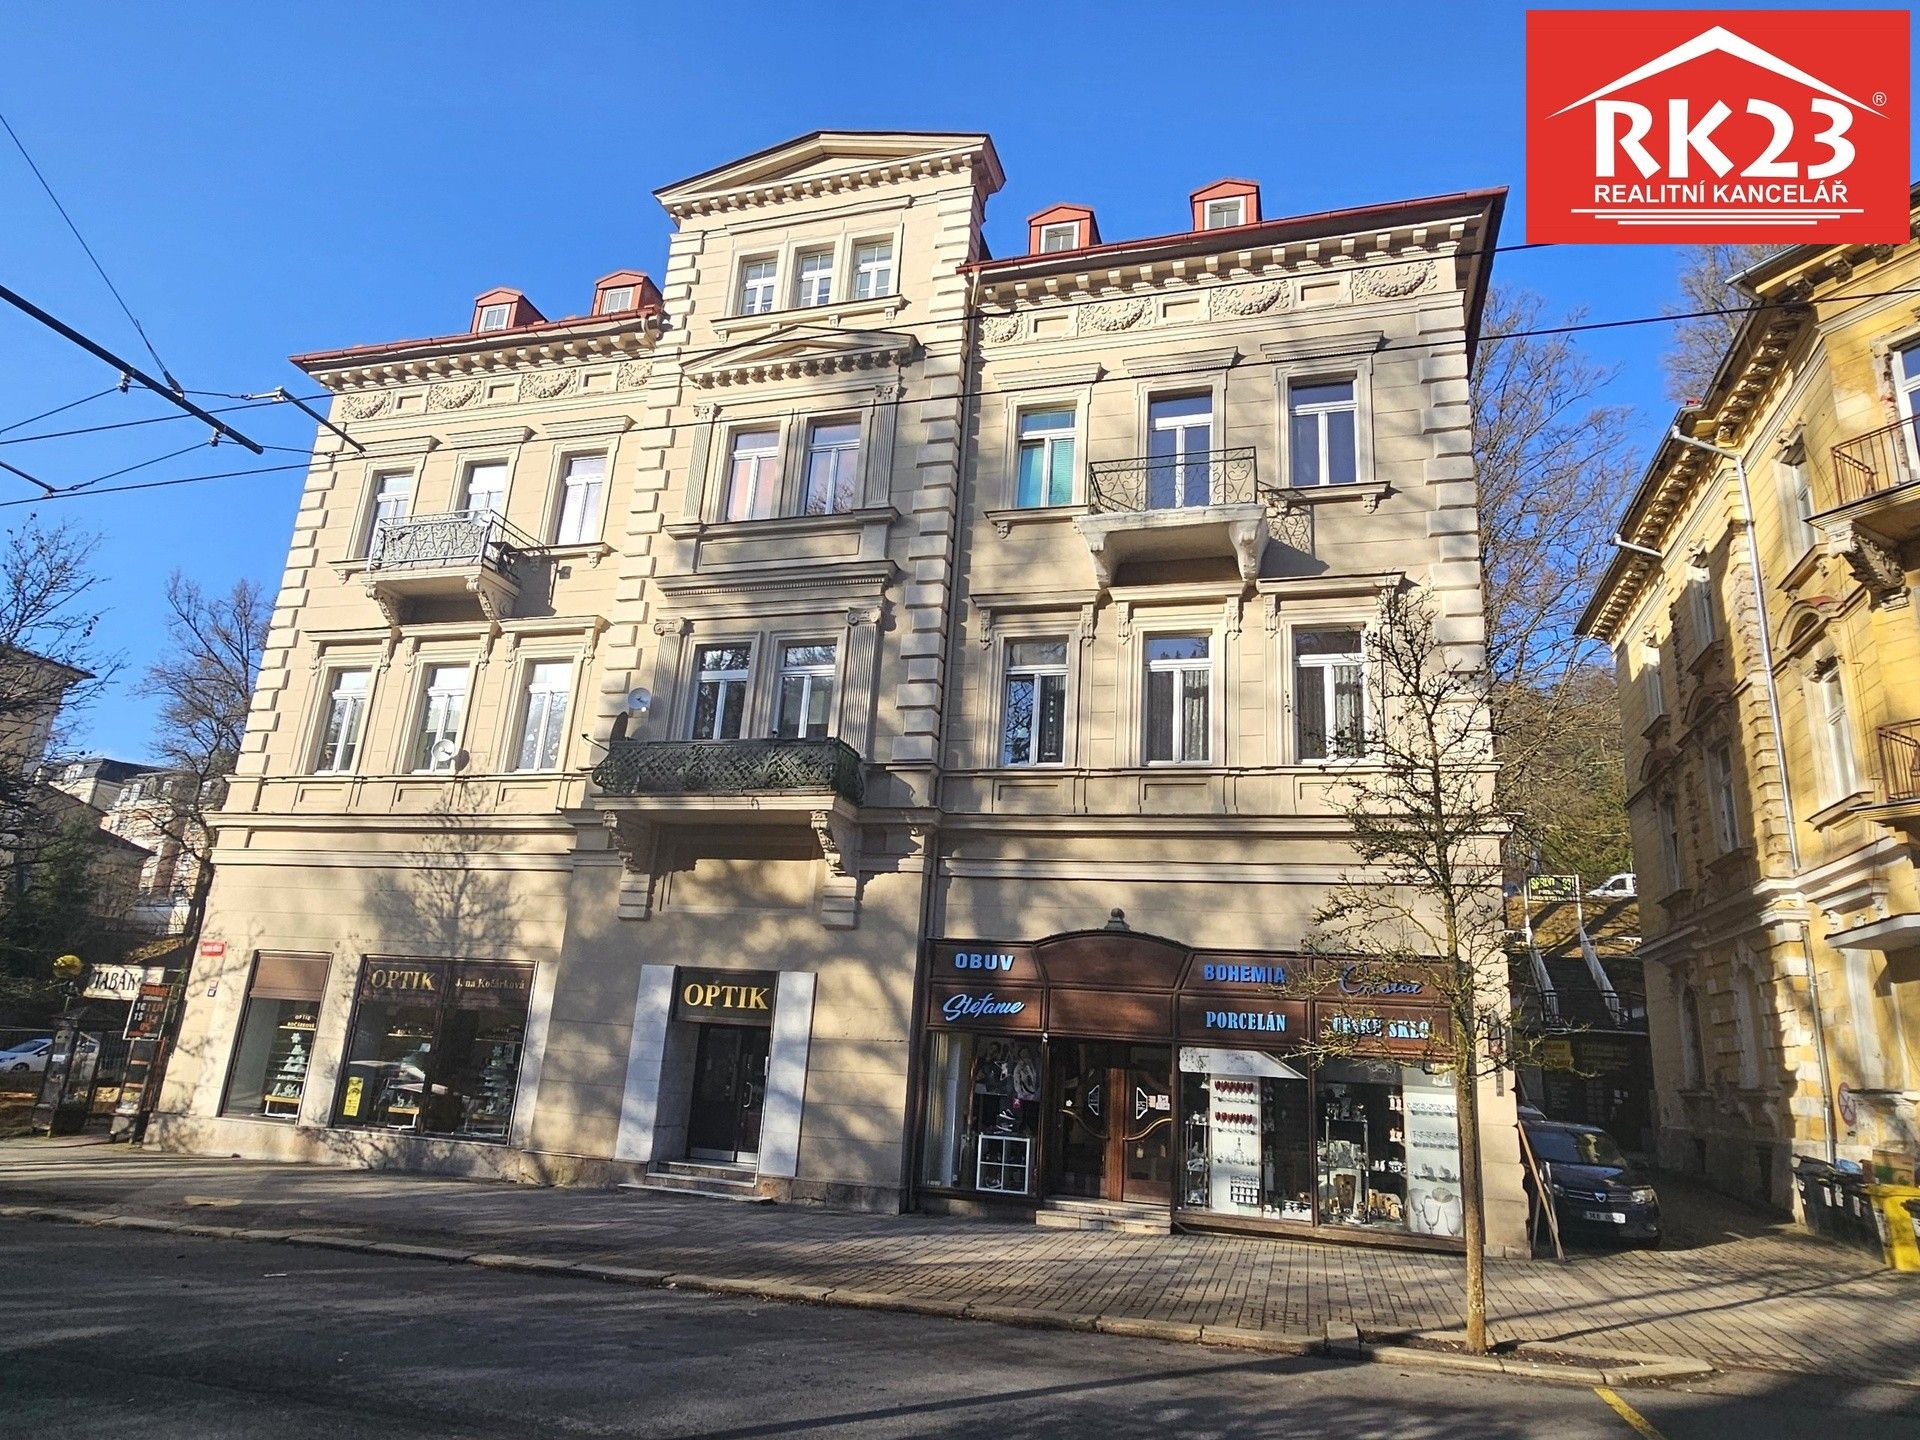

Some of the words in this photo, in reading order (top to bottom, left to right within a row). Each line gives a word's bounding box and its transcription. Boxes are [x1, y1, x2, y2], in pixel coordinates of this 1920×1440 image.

[955, 953, 1014, 971] OBUV
[94, 969, 142, 991] TABÁK
[371, 969, 435, 991] OPTIK
[455, 978, 476, 988] Jna
[1203, 964, 1286, 984] BOHEMIA
[684, 983, 770, 1010] OPTIK
[942, 993, 1025, 1021] Stefanie
[1206, 1010, 1286, 1032] PORCELÁN
